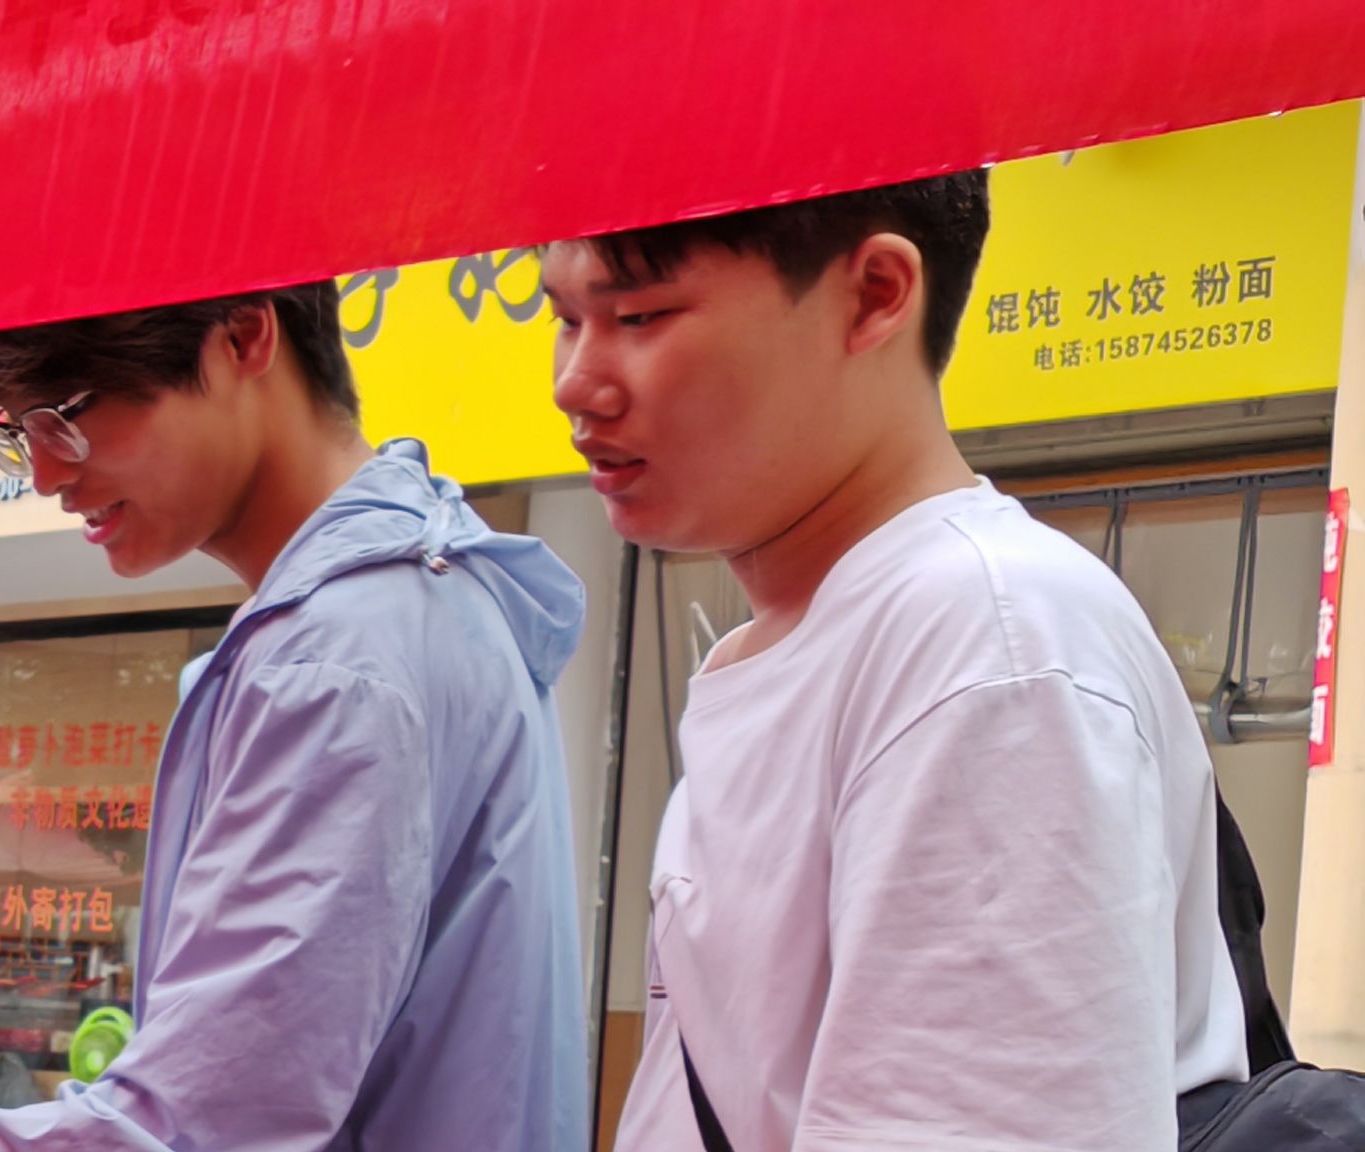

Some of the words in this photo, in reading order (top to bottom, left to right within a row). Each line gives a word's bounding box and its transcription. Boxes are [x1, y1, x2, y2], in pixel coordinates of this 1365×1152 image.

[986, 286, 1060, 334] 馄饨
[1086, 271, 1166, 320] 水饺
[1192, 255, 1276, 308] 粉面
[1034, 318, 1272, 371] 电话:15874526378
